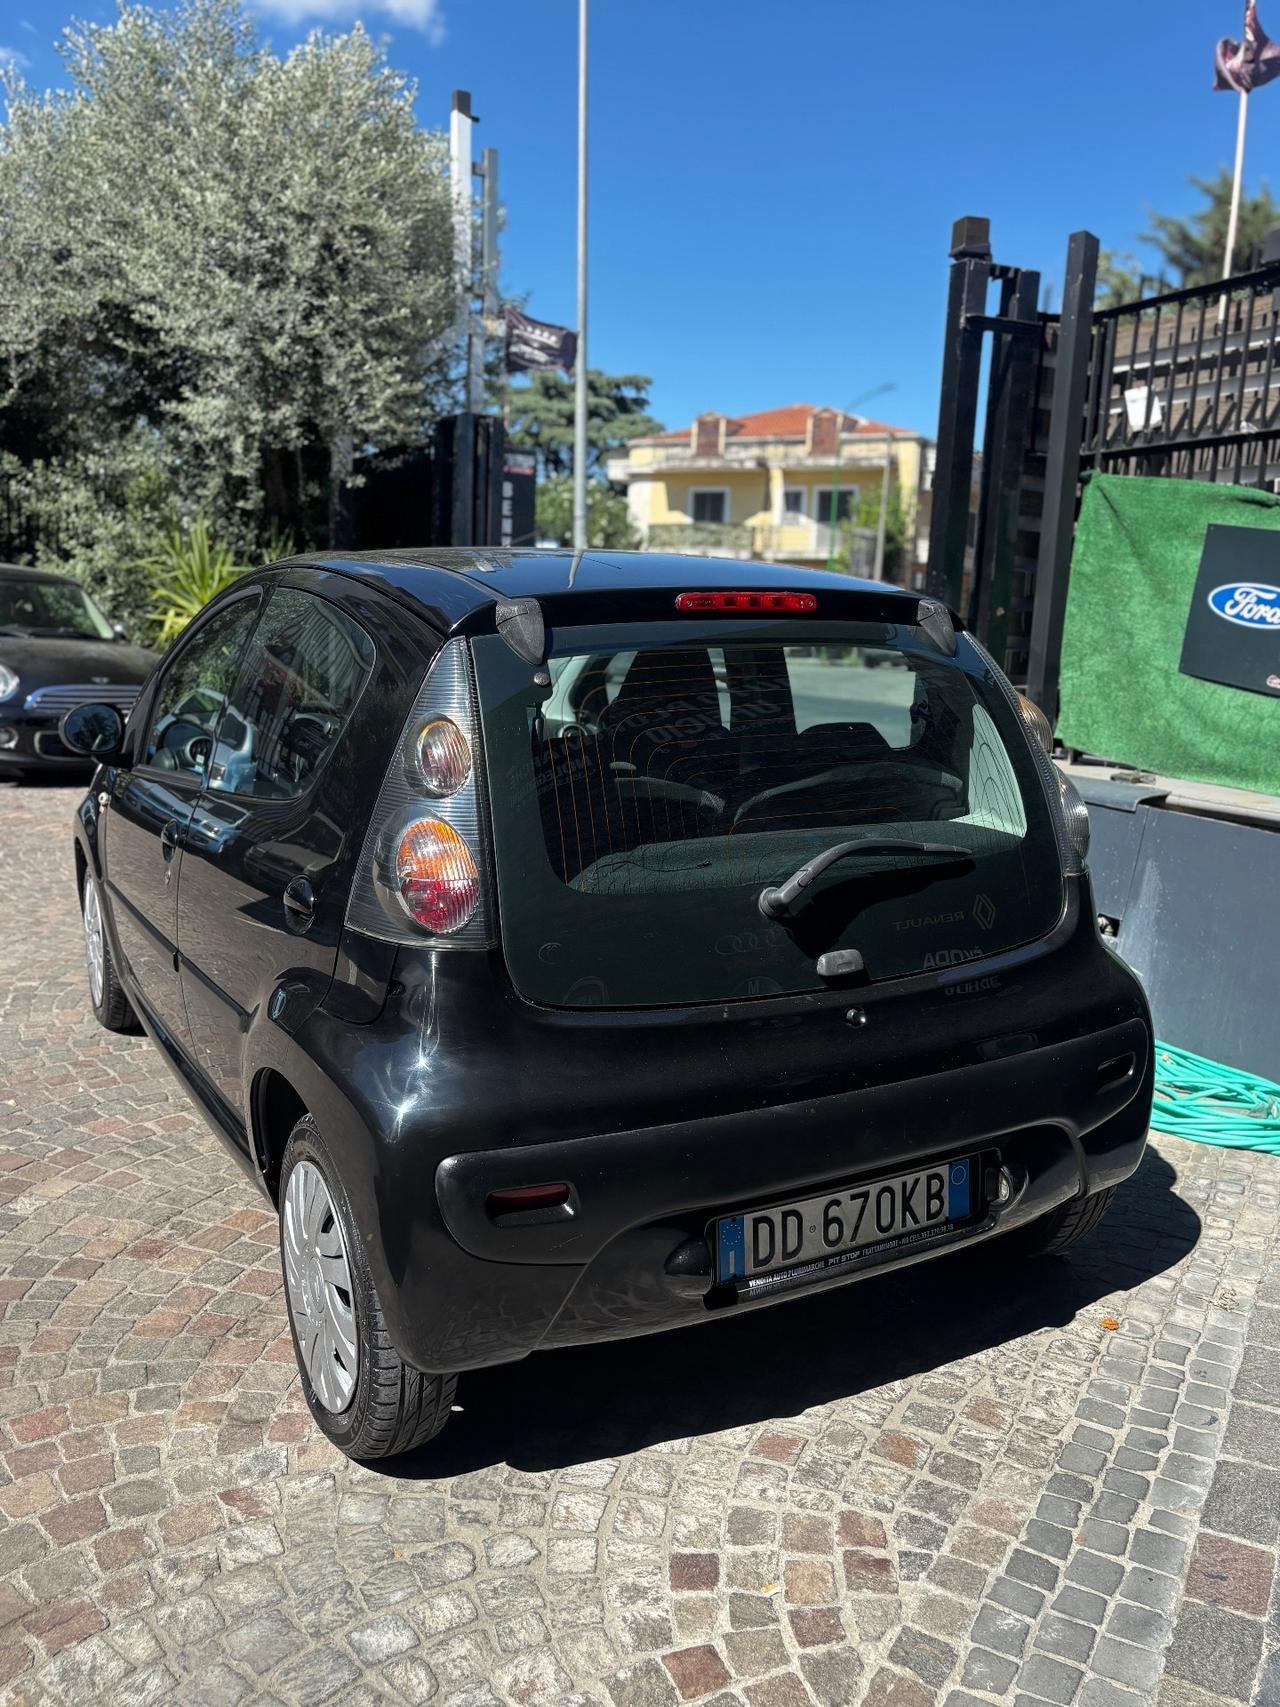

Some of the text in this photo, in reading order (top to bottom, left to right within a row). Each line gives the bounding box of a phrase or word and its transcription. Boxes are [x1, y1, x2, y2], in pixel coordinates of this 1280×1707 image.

[752, 1173, 945, 1269] DD 670KB
[828, 1257, 841, 1266] PIT
[841, 1251, 860, 1263] STOP
